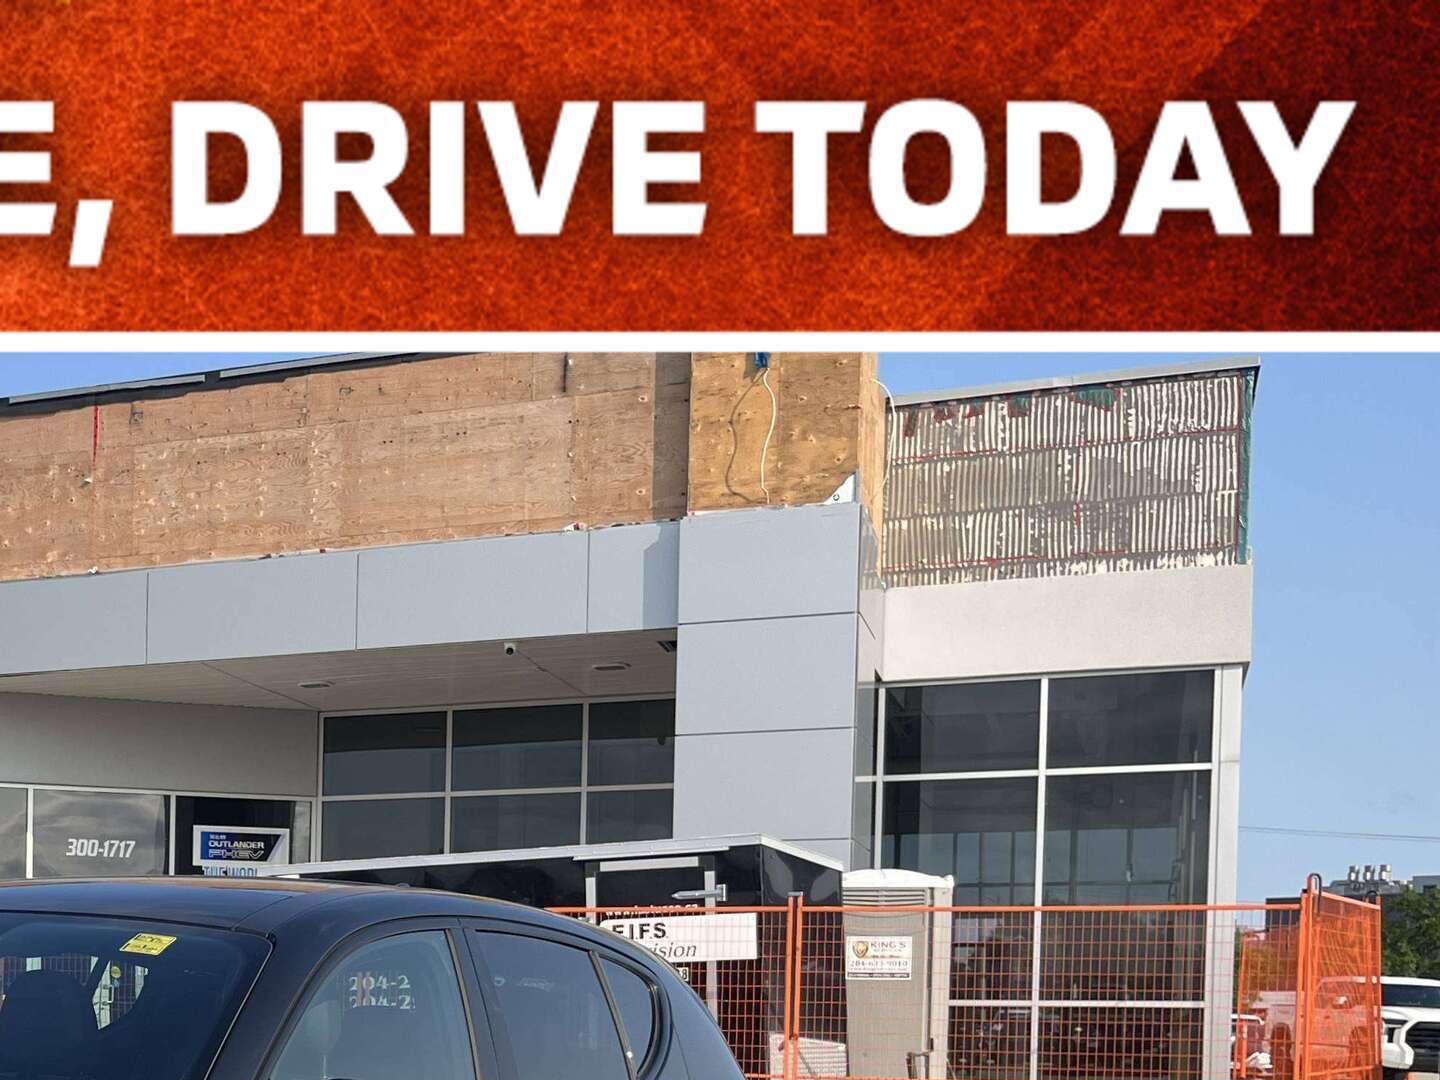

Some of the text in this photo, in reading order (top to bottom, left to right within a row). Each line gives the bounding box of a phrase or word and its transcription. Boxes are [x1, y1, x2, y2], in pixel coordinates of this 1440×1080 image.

[66, 838, 135, 858] 300-1717
[208, 841, 264, 849] OUTLANDER
[652, 941, 697, 957] ision
